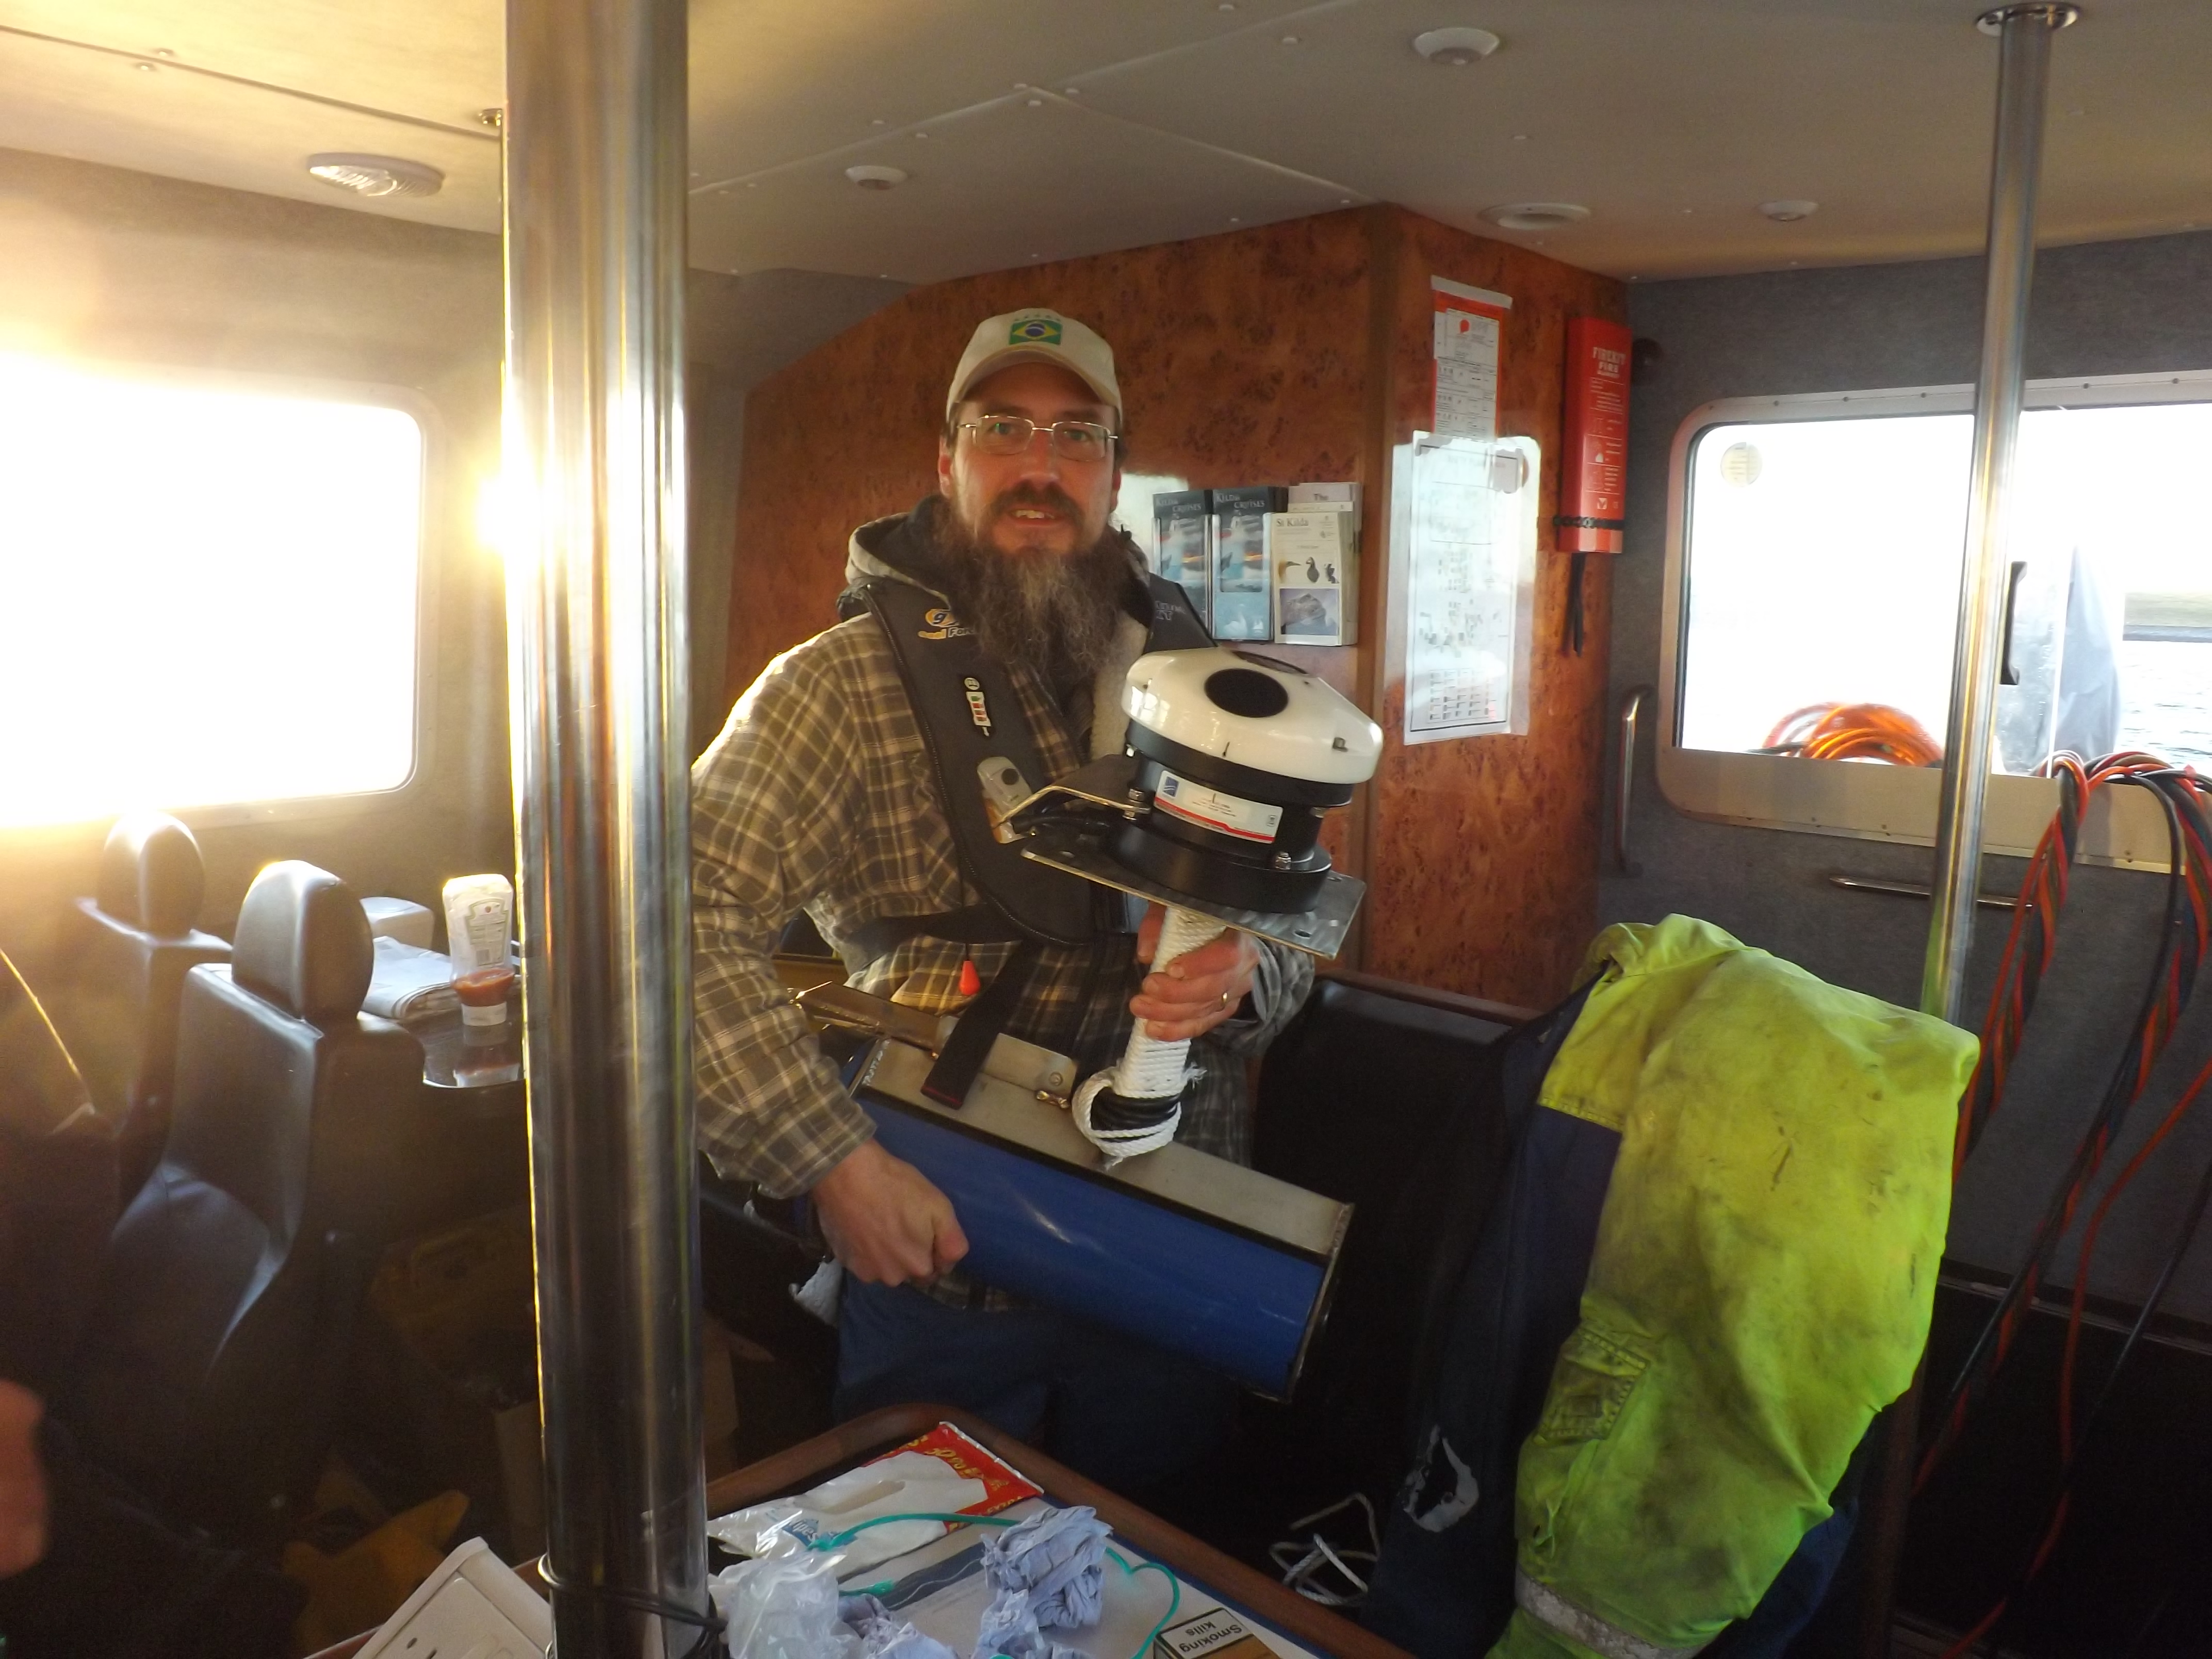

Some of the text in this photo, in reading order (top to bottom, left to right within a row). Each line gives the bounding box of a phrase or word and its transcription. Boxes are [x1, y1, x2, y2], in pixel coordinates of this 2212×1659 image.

[1287, 517, 1309, 527] Kilda
[1185, 1621, 1217, 1636] kills
[1178, 1624, 1242, 1652] Smoking
